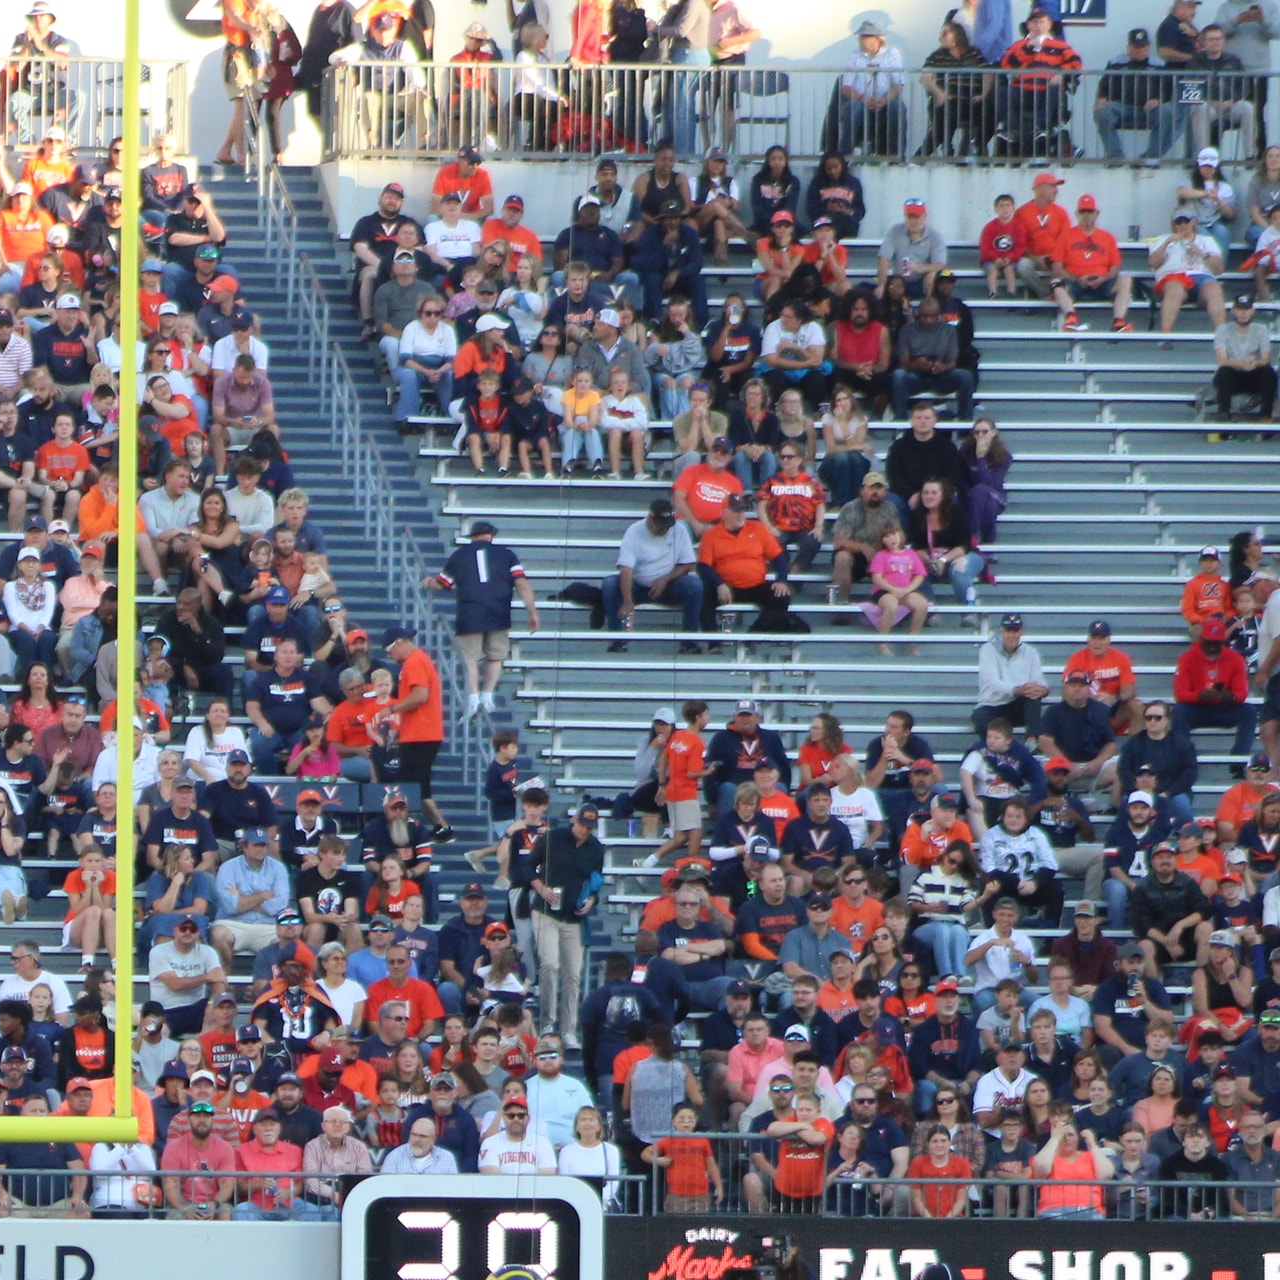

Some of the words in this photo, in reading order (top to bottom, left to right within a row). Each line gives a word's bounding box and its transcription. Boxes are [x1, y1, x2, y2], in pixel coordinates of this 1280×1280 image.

[771, 485, 812, 498] VIRGINIA
[1129, 851, 1145, 876] 4
[498, 1152, 537, 1166] VIRGINIA
[685, 1228, 740, 1244] DAIRY
